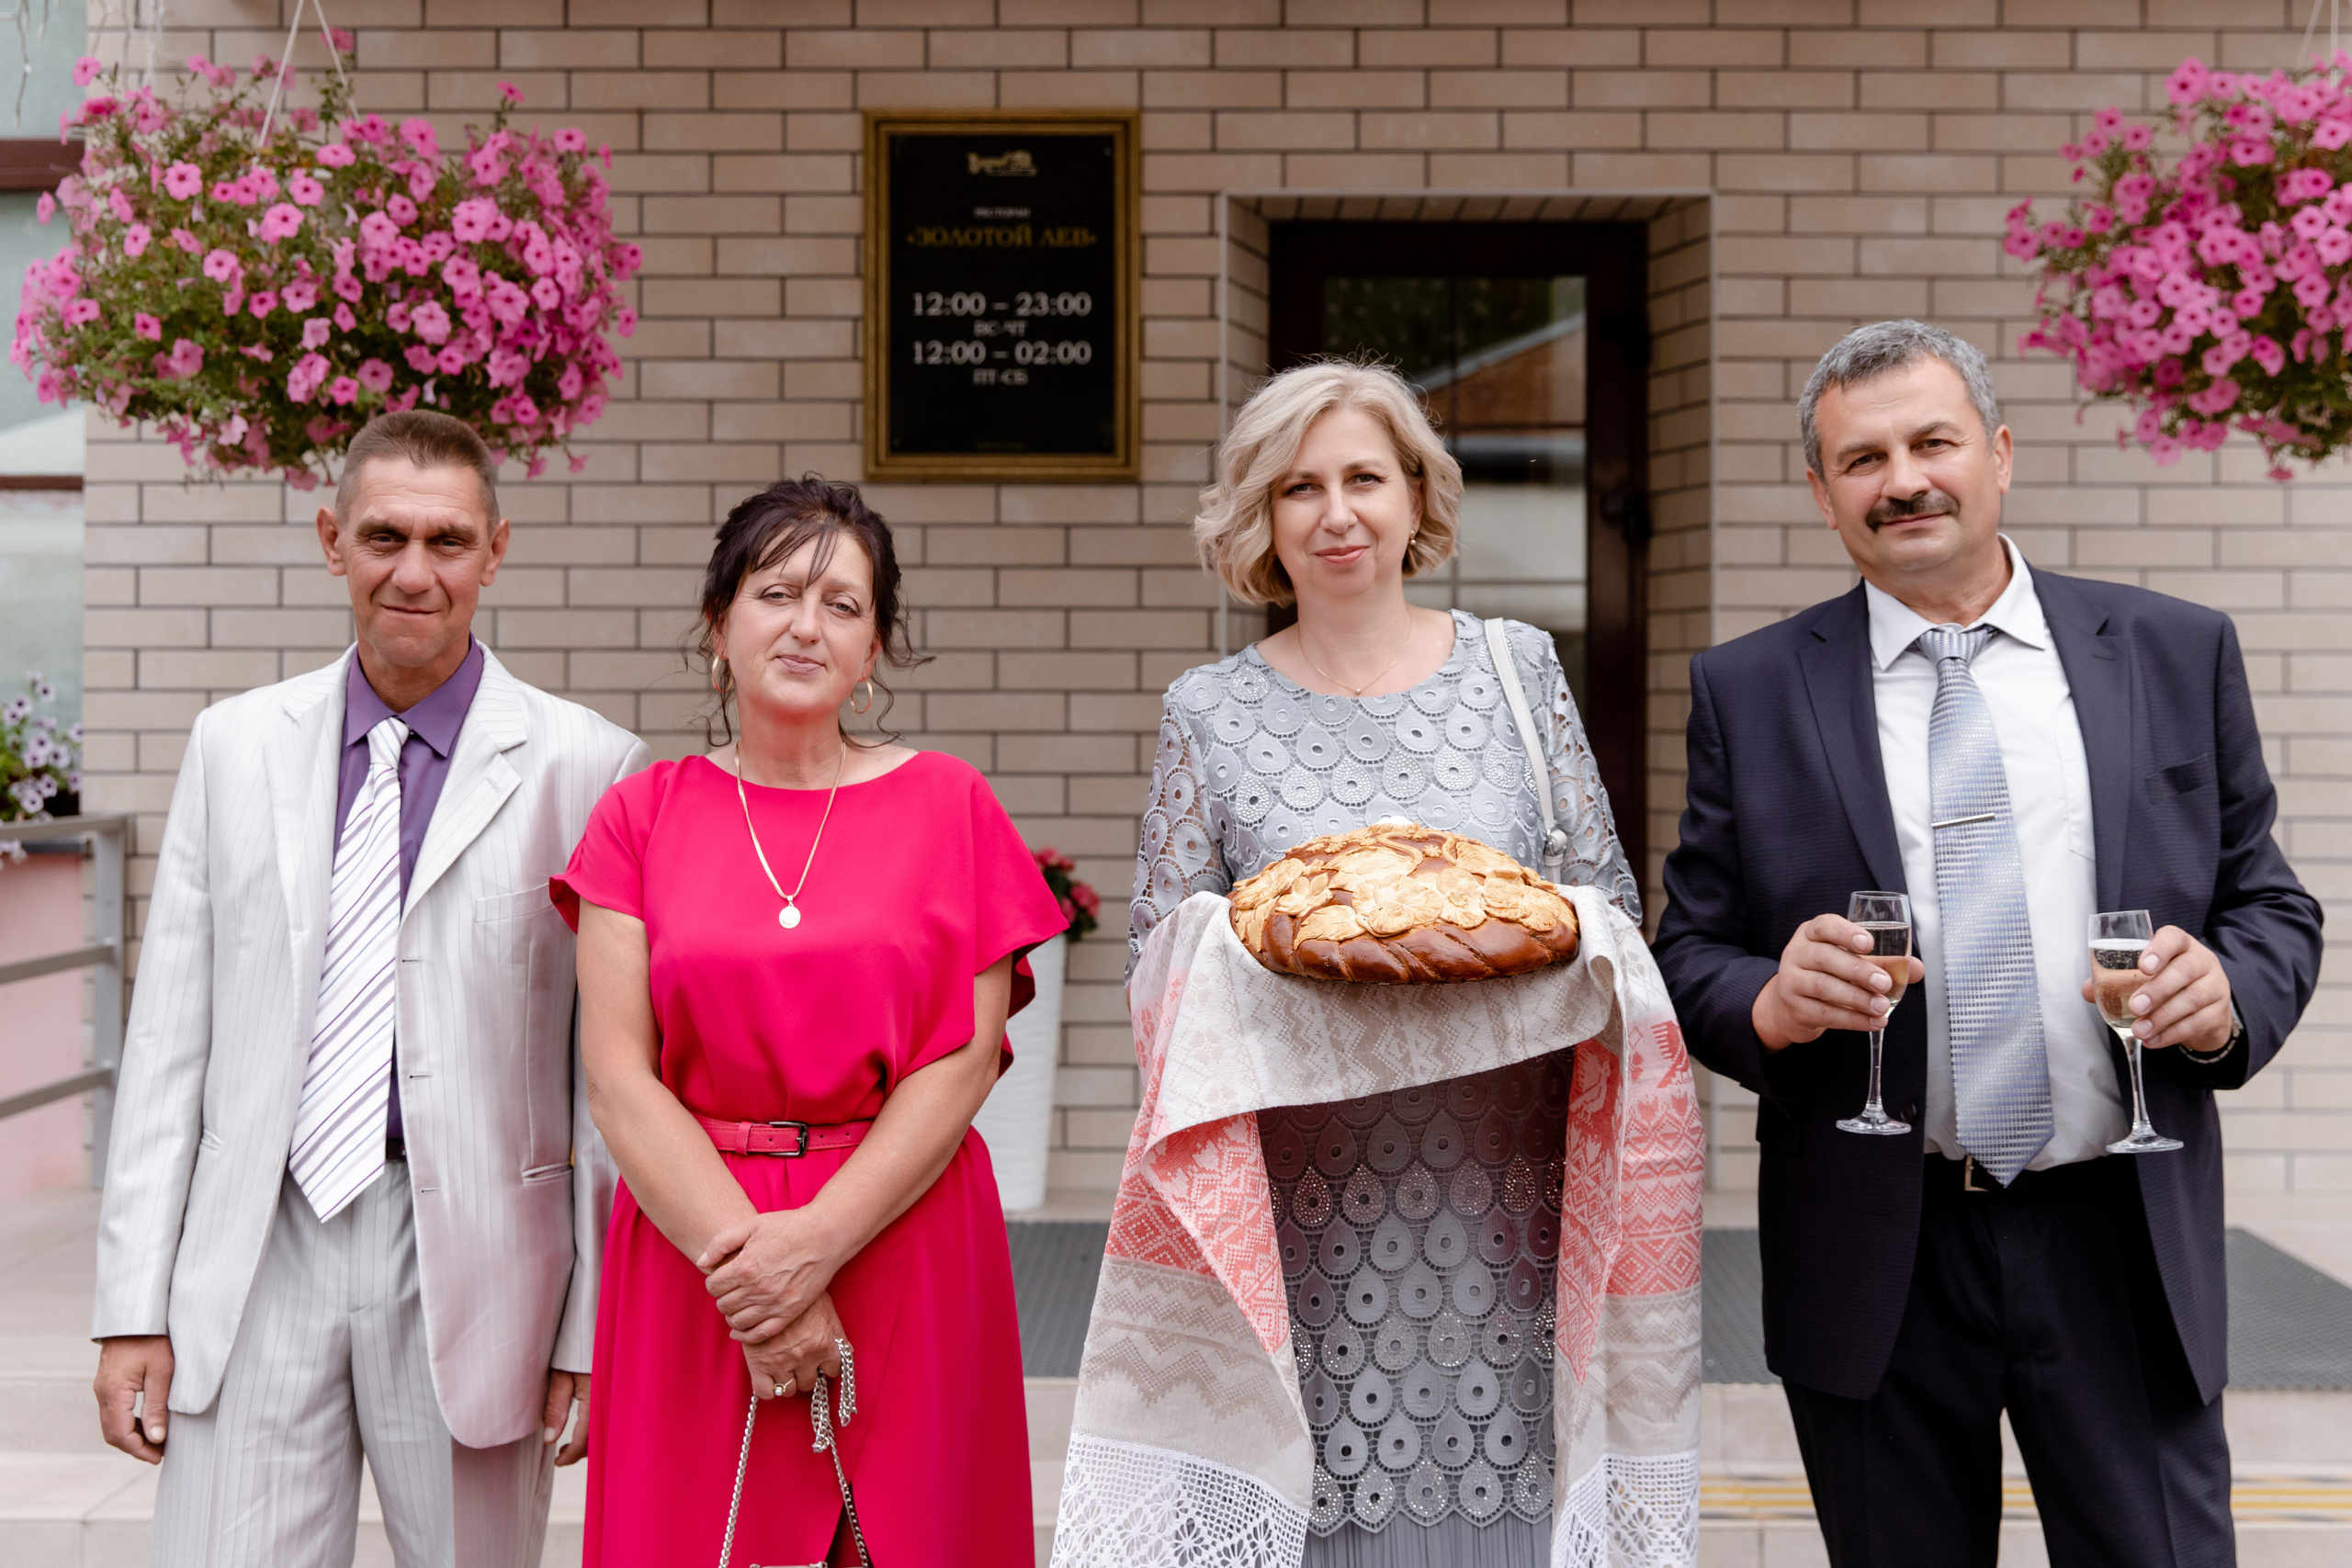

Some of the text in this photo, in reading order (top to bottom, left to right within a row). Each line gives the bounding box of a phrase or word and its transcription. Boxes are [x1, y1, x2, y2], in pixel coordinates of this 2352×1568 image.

[913, 292, 986, 316] 12:00
[1014, 291, 1092, 316] 23:00
[913, 340, 986, 365] 12:00
[1014, 340, 1092, 365] 02:00
